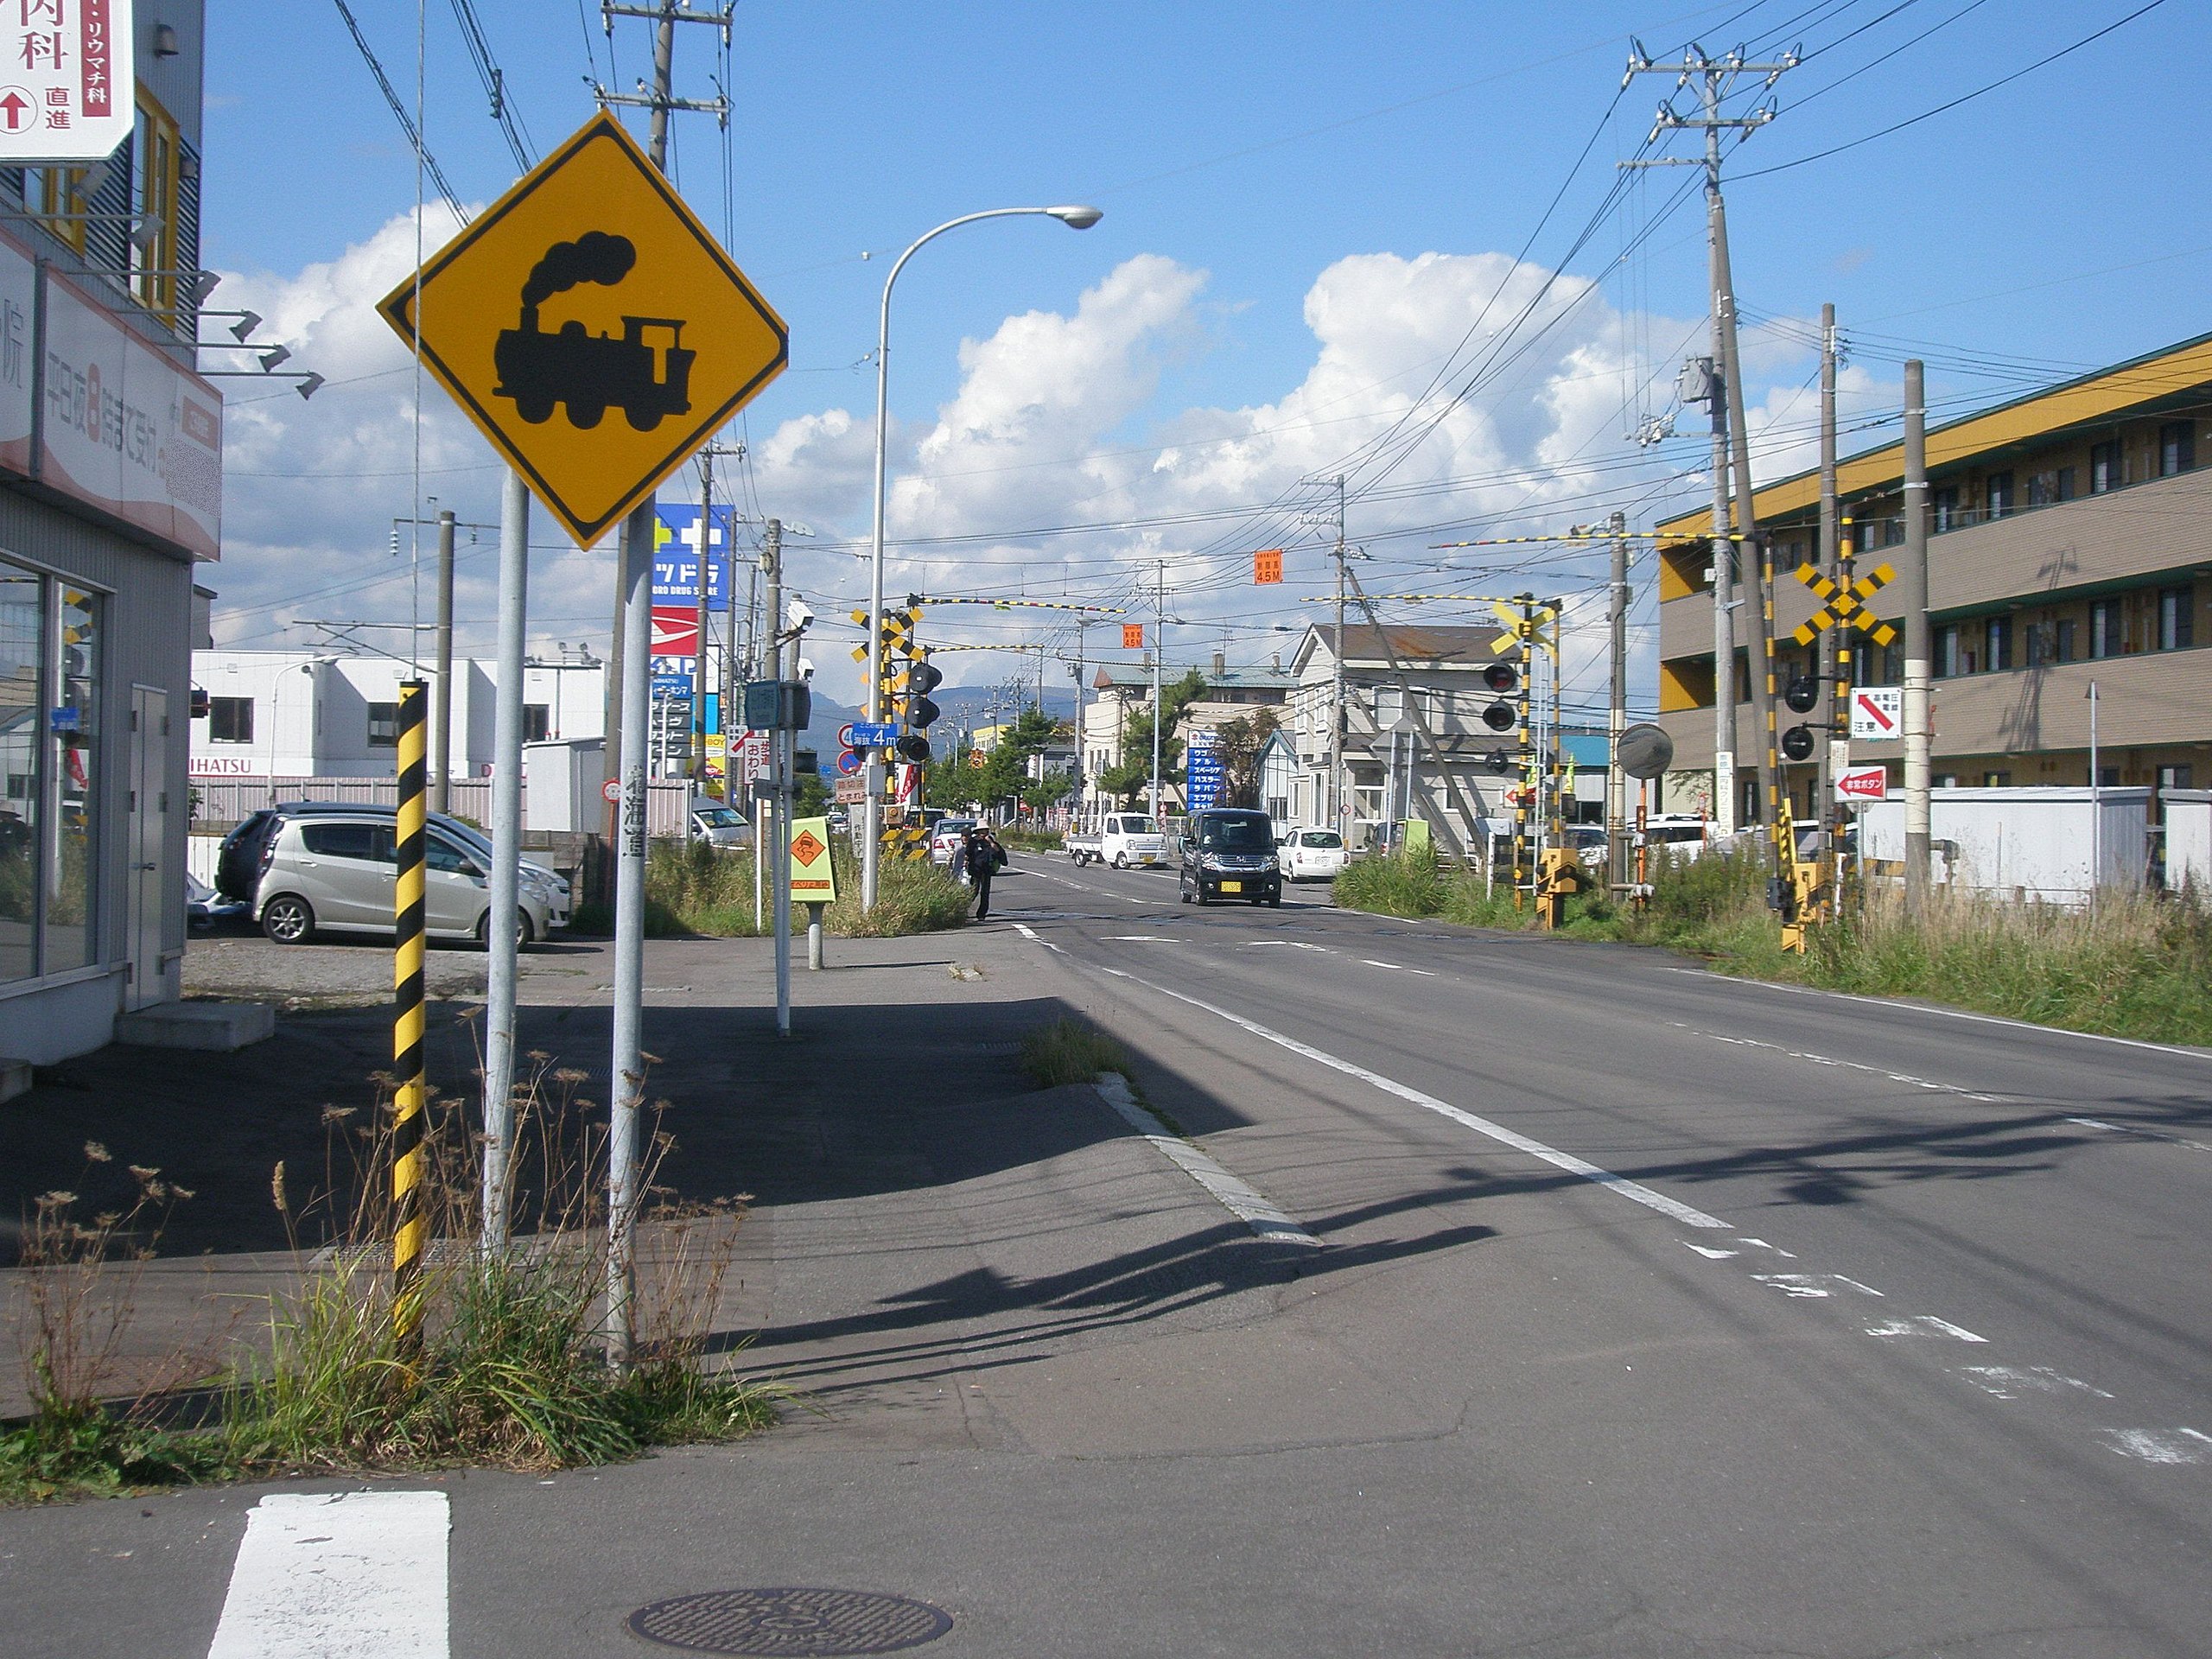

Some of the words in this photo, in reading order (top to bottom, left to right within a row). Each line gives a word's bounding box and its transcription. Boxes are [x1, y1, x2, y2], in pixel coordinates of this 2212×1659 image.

[86, 0, 106, 104] ・リウマチ科
[45, 86, 71, 130] 直進
[1257, 571, 1280, 582] 4.5M
[693, 587, 718, 595] SRE
[1853, 721, 1877, 732] 注意
[747, 744, 760, 781] おわり
[1846, 779, 1882, 790] 非常ボタン
